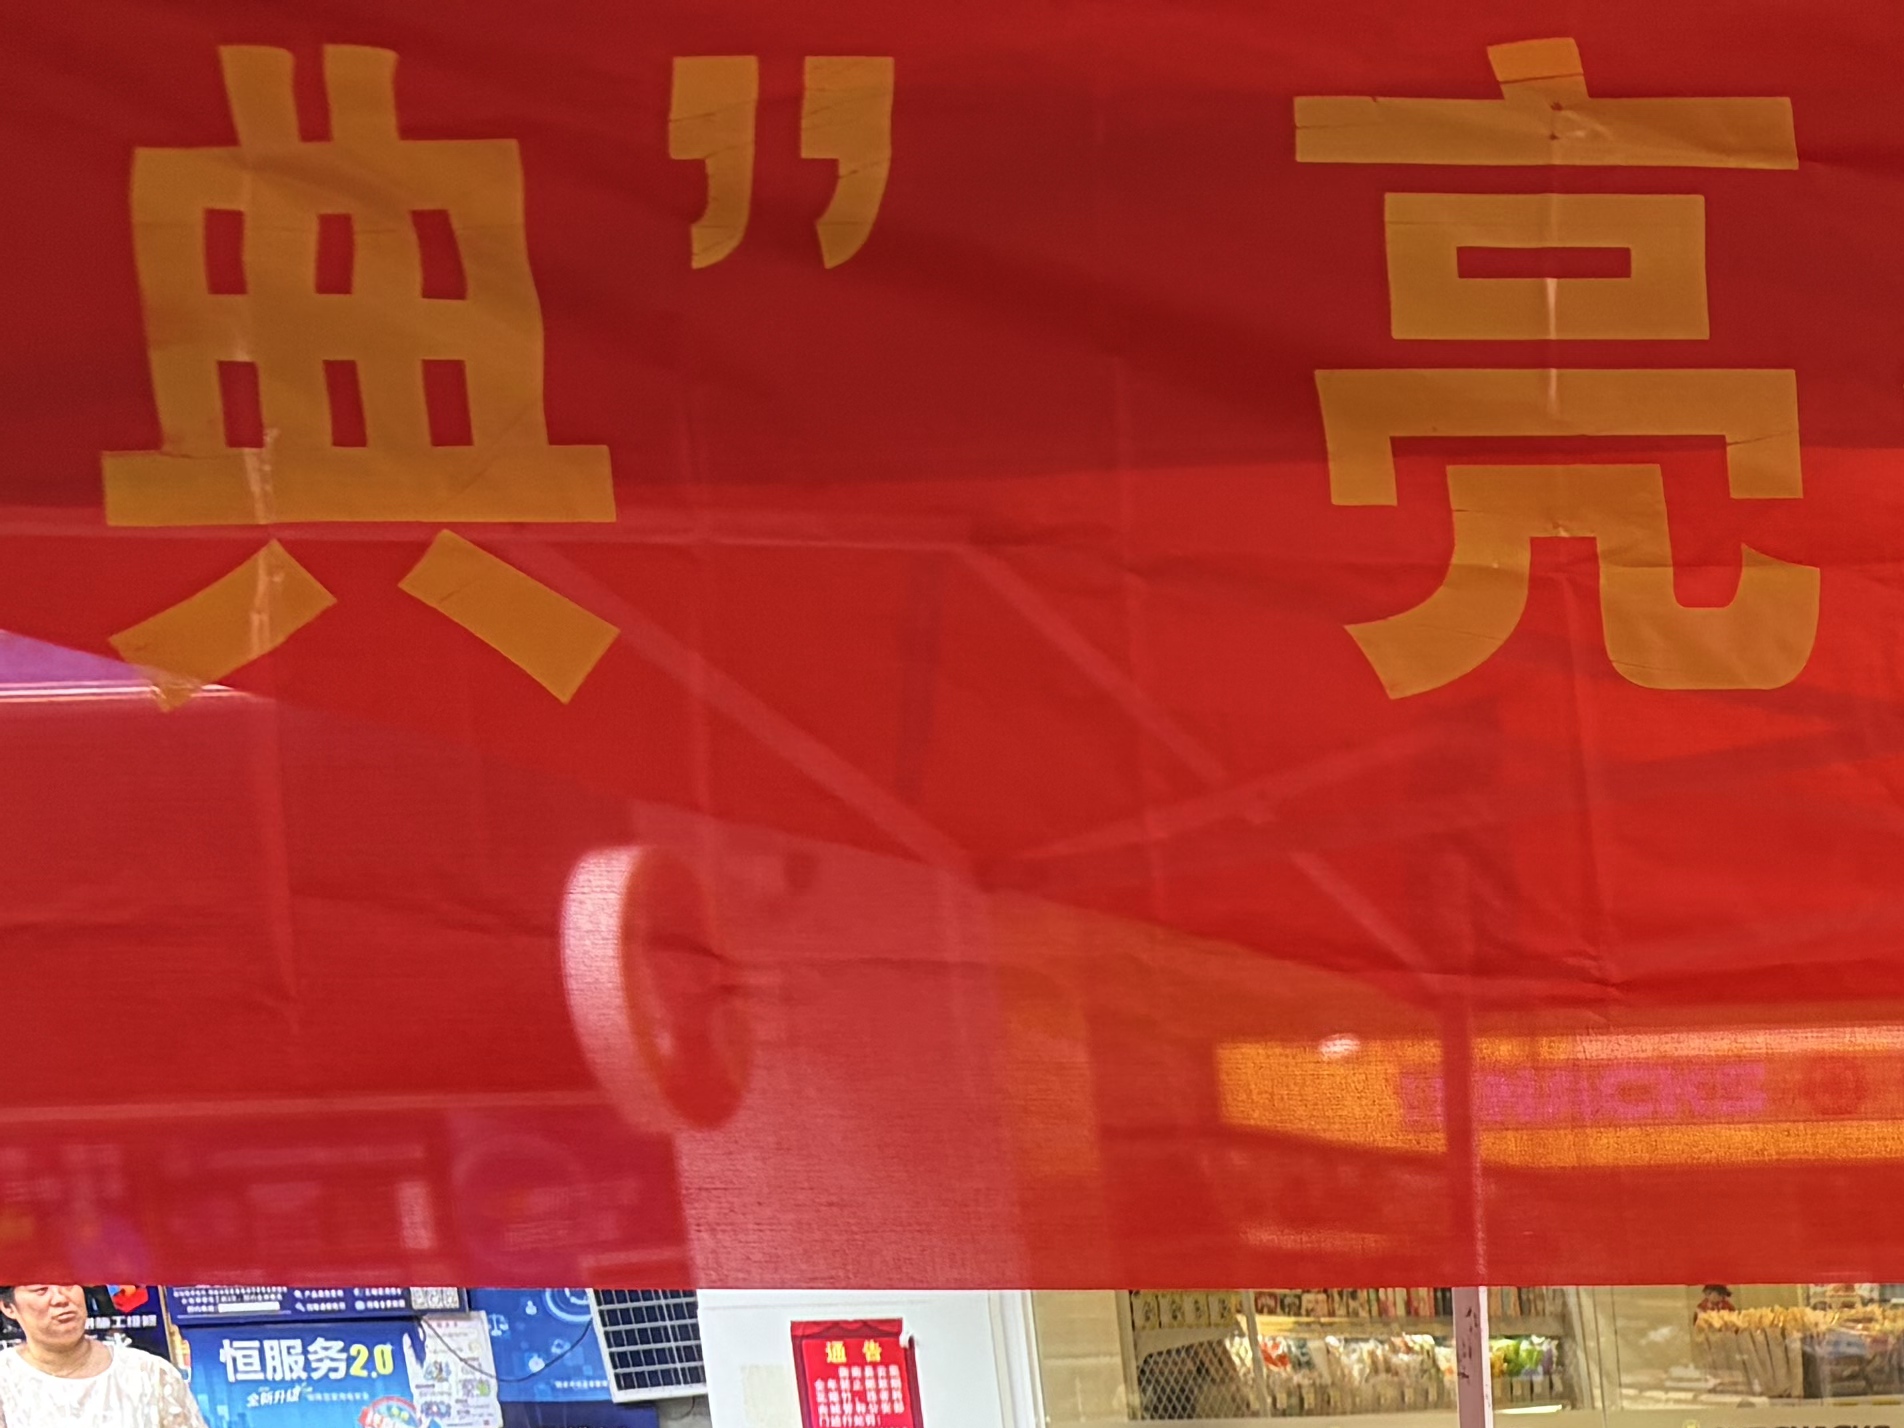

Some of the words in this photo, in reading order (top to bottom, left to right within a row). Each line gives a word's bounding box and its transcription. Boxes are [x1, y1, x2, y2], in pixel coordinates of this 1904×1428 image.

[219, 1337, 395, 1383] 恒服务2.0
[826, 1339, 882, 1364] 通告
